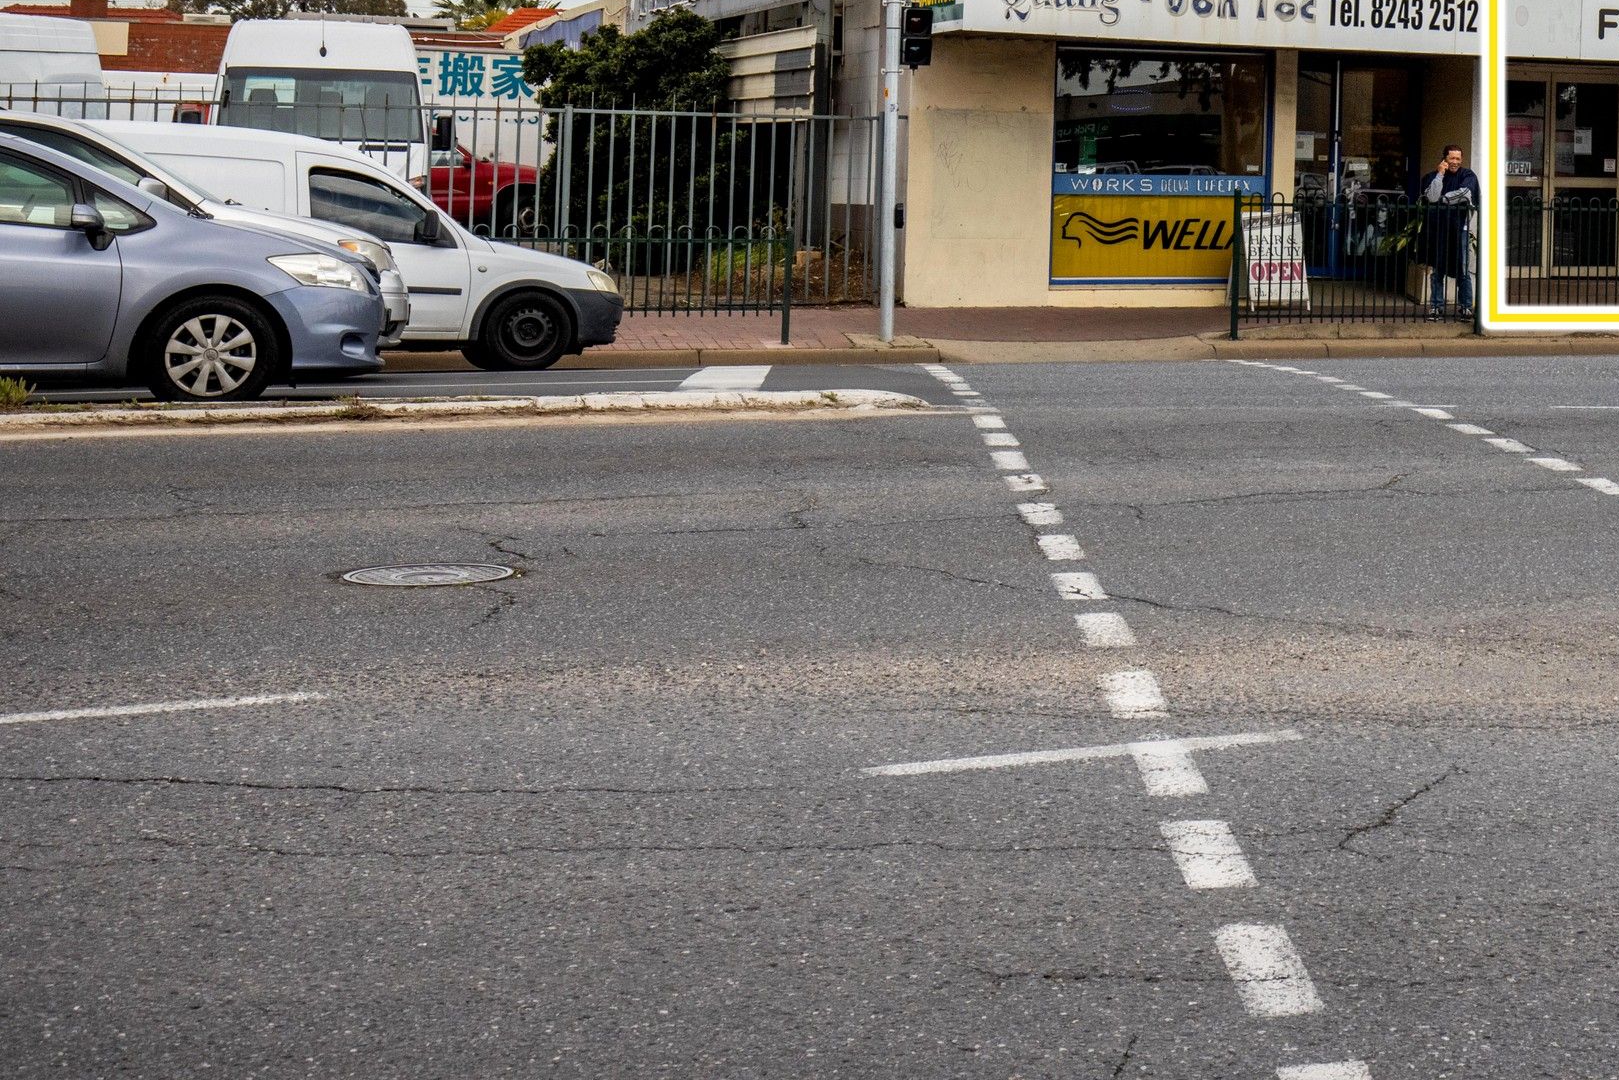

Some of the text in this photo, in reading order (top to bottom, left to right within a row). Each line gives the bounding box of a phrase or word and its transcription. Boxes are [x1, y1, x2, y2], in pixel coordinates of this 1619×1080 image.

[1507, 161, 1530, 174] OPEN
[1070, 178, 1153, 192] WORKS
[1250, 234, 1298, 245] HAR &
[1250, 246, 1301, 257] BEAUTY
[1250, 261, 1303, 281] OPEN
